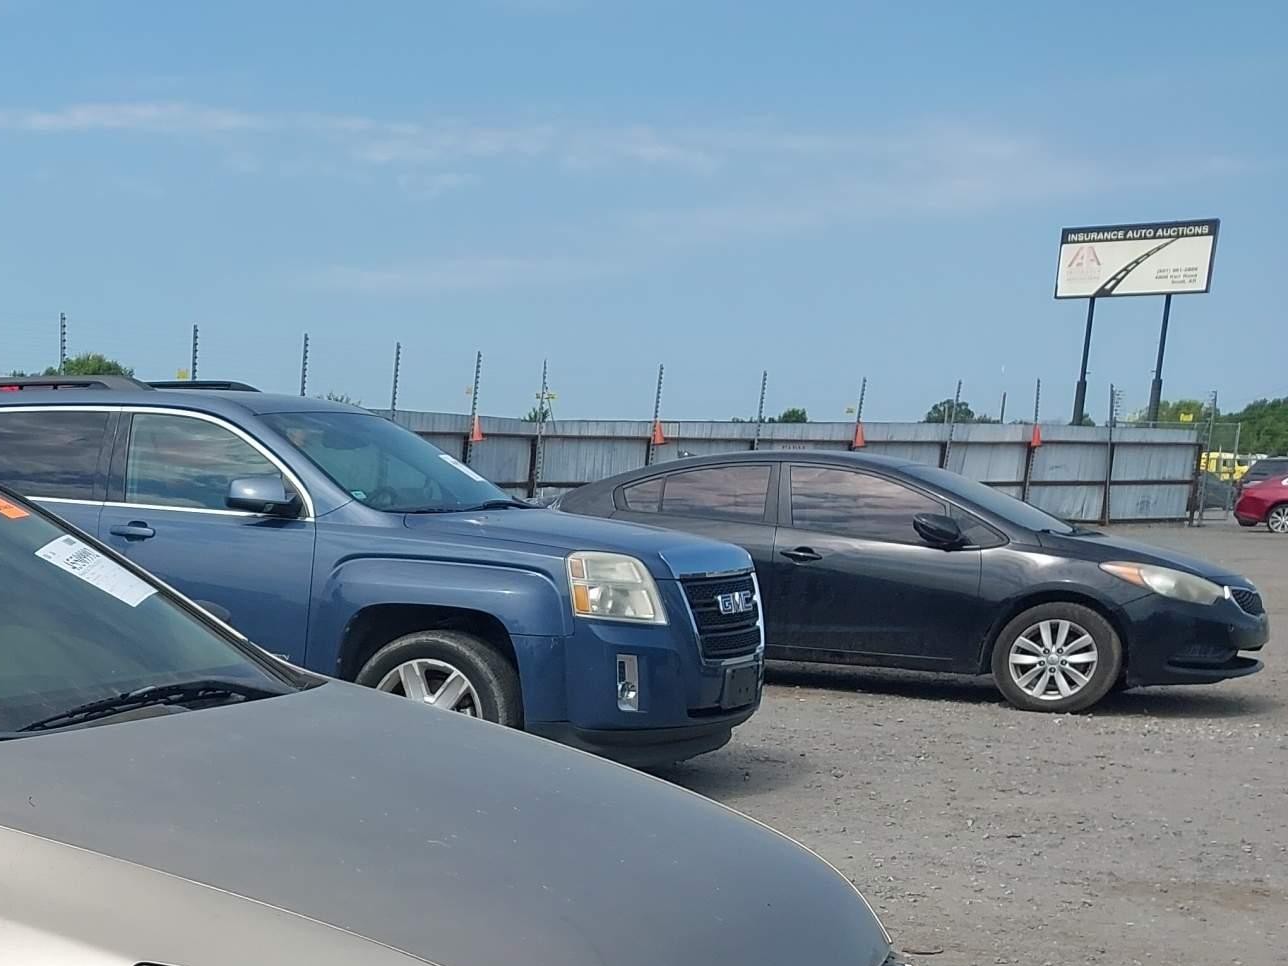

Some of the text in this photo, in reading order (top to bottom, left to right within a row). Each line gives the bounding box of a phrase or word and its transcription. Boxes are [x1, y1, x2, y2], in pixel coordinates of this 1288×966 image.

[1067, 225, 1209, 242] INSURANCE AUTO AUCTIONS
[718, 590, 753, 615] GMC
